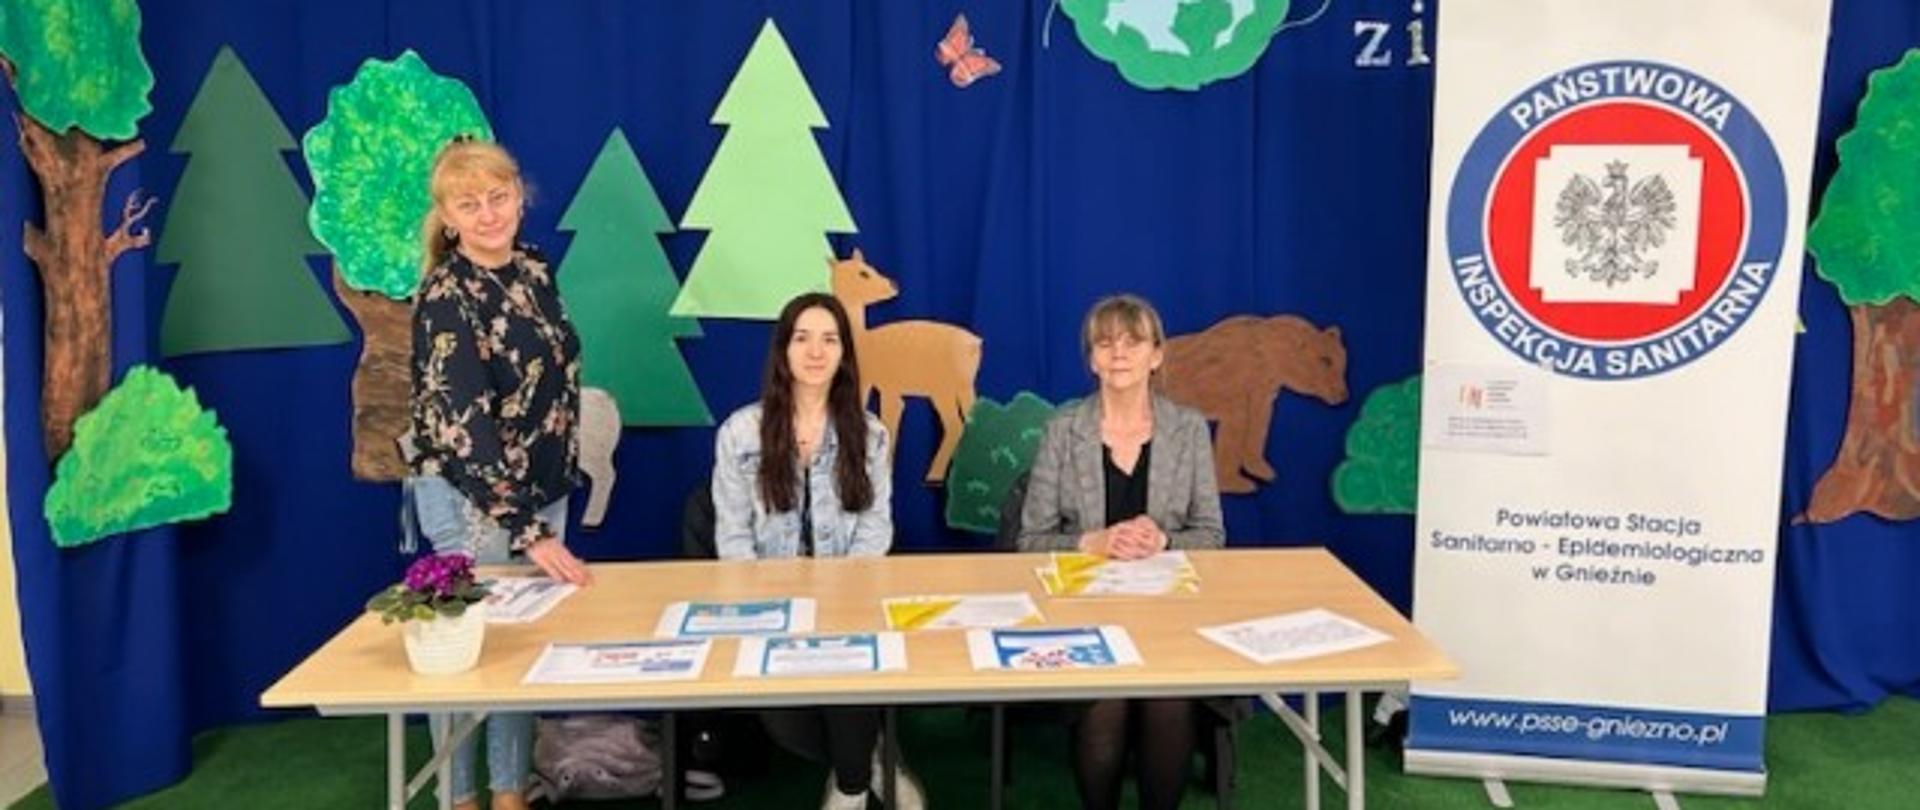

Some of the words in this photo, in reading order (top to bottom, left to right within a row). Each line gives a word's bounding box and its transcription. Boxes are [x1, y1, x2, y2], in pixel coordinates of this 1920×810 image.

[1510, 66, 1734, 131] PAŃSTWOWA
[1455, 254, 1597, 376] INSPEKCJA
[1606, 259, 1771, 375] SANITARNA
[1497, 509, 1619, 530] Powiatowa
[1625, 513, 1702, 537] Stacja
[1430, 530, 1535, 555] Sanitarno
[1558, 536, 1764, 567] Epidemiologiczna
[1531, 567, 1548, 580] w
[1556, 564, 1656, 586] Gnieźnie
[1449, 708, 1728, 743] www.psse-gniezno.pl
